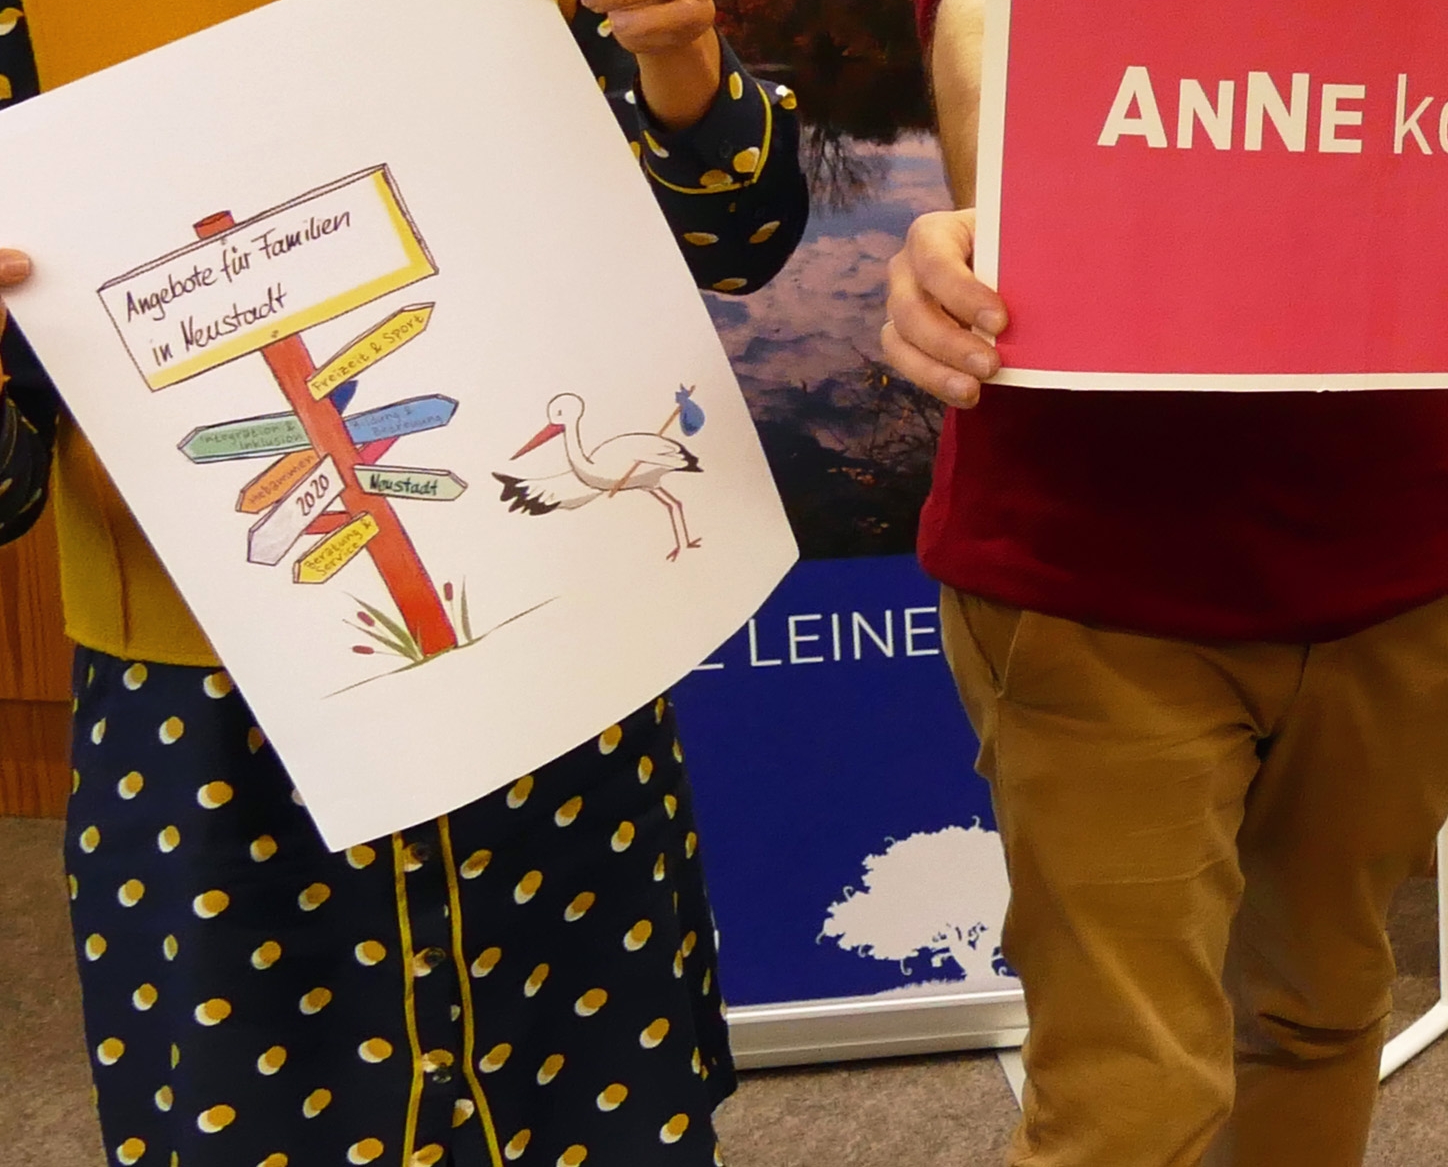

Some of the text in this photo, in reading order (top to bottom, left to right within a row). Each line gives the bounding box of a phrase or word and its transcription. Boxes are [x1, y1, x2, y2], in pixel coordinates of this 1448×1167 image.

[126, 211, 351, 323] Angebote für Familien
[149, 283, 288, 367] in Neustadt
[311, 353, 370, 392] Freizeit
[382, 315, 425, 344] Sport
[295, 474, 330, 517] 2020
[369, 473, 438, 497] Neustadt
[748, 605, 940, 666] LEINE
